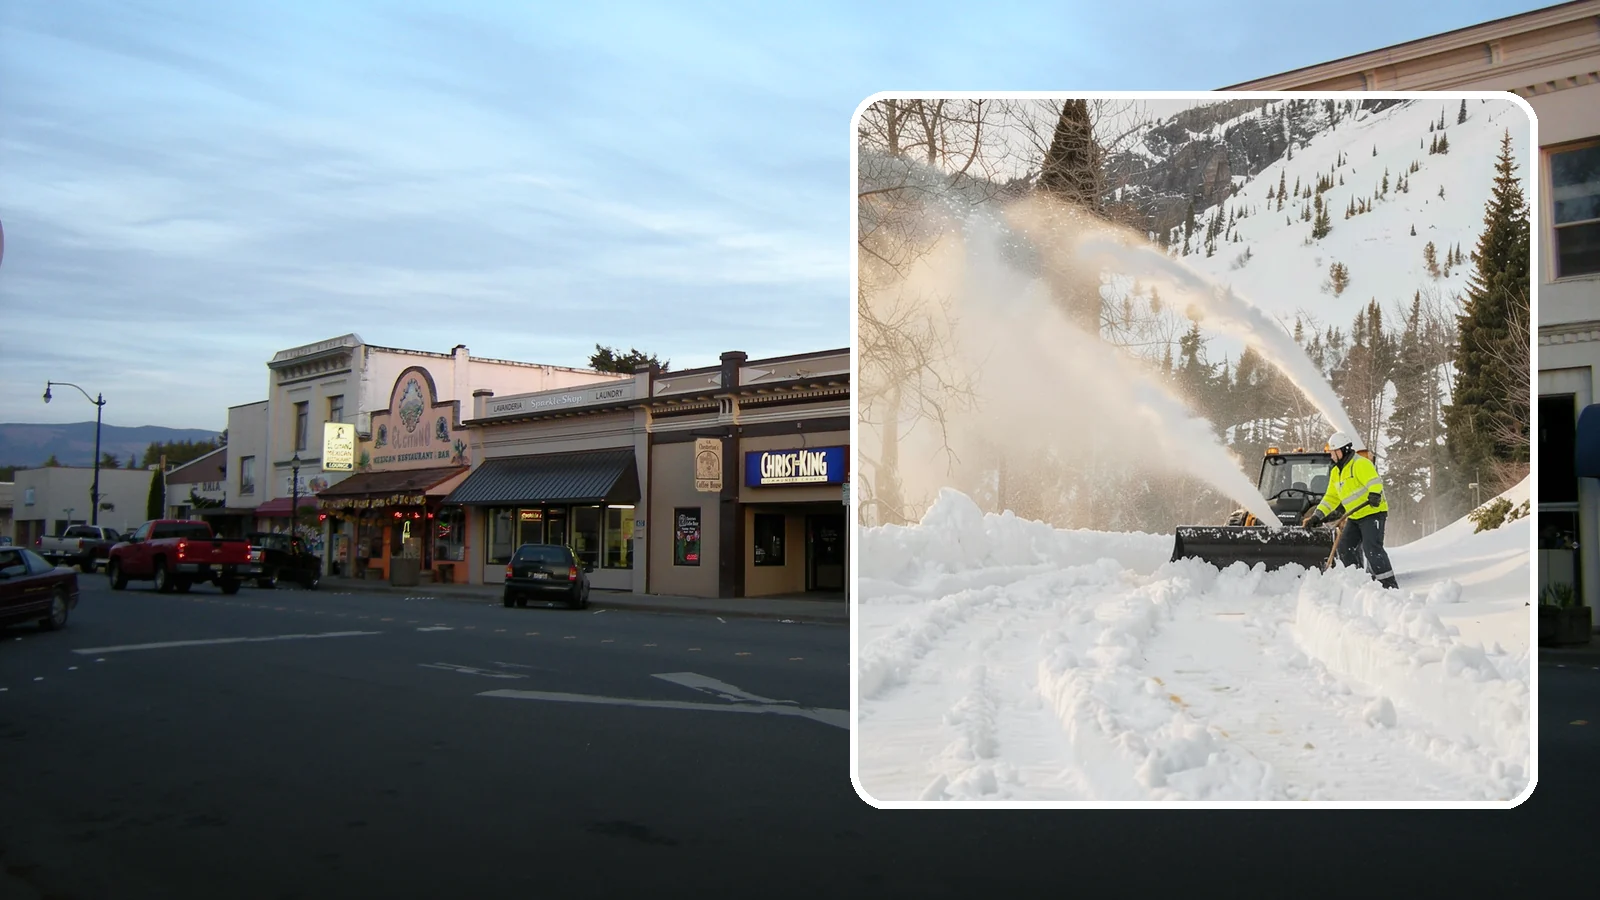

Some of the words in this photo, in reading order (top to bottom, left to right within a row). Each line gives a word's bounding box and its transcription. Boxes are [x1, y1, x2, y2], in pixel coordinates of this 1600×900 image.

[595, 389, 623, 400] LAUNDRY
[493, 402, 522, 413] LAVANDERIA
[530, 399, 561, 409] Sparkle
[561, 394, 582, 404] Shop
[373, 455, 396, 464] MEXICAN
[397, 451, 433, 462] RESTAURANT
[437, 450, 450, 459] BAR
